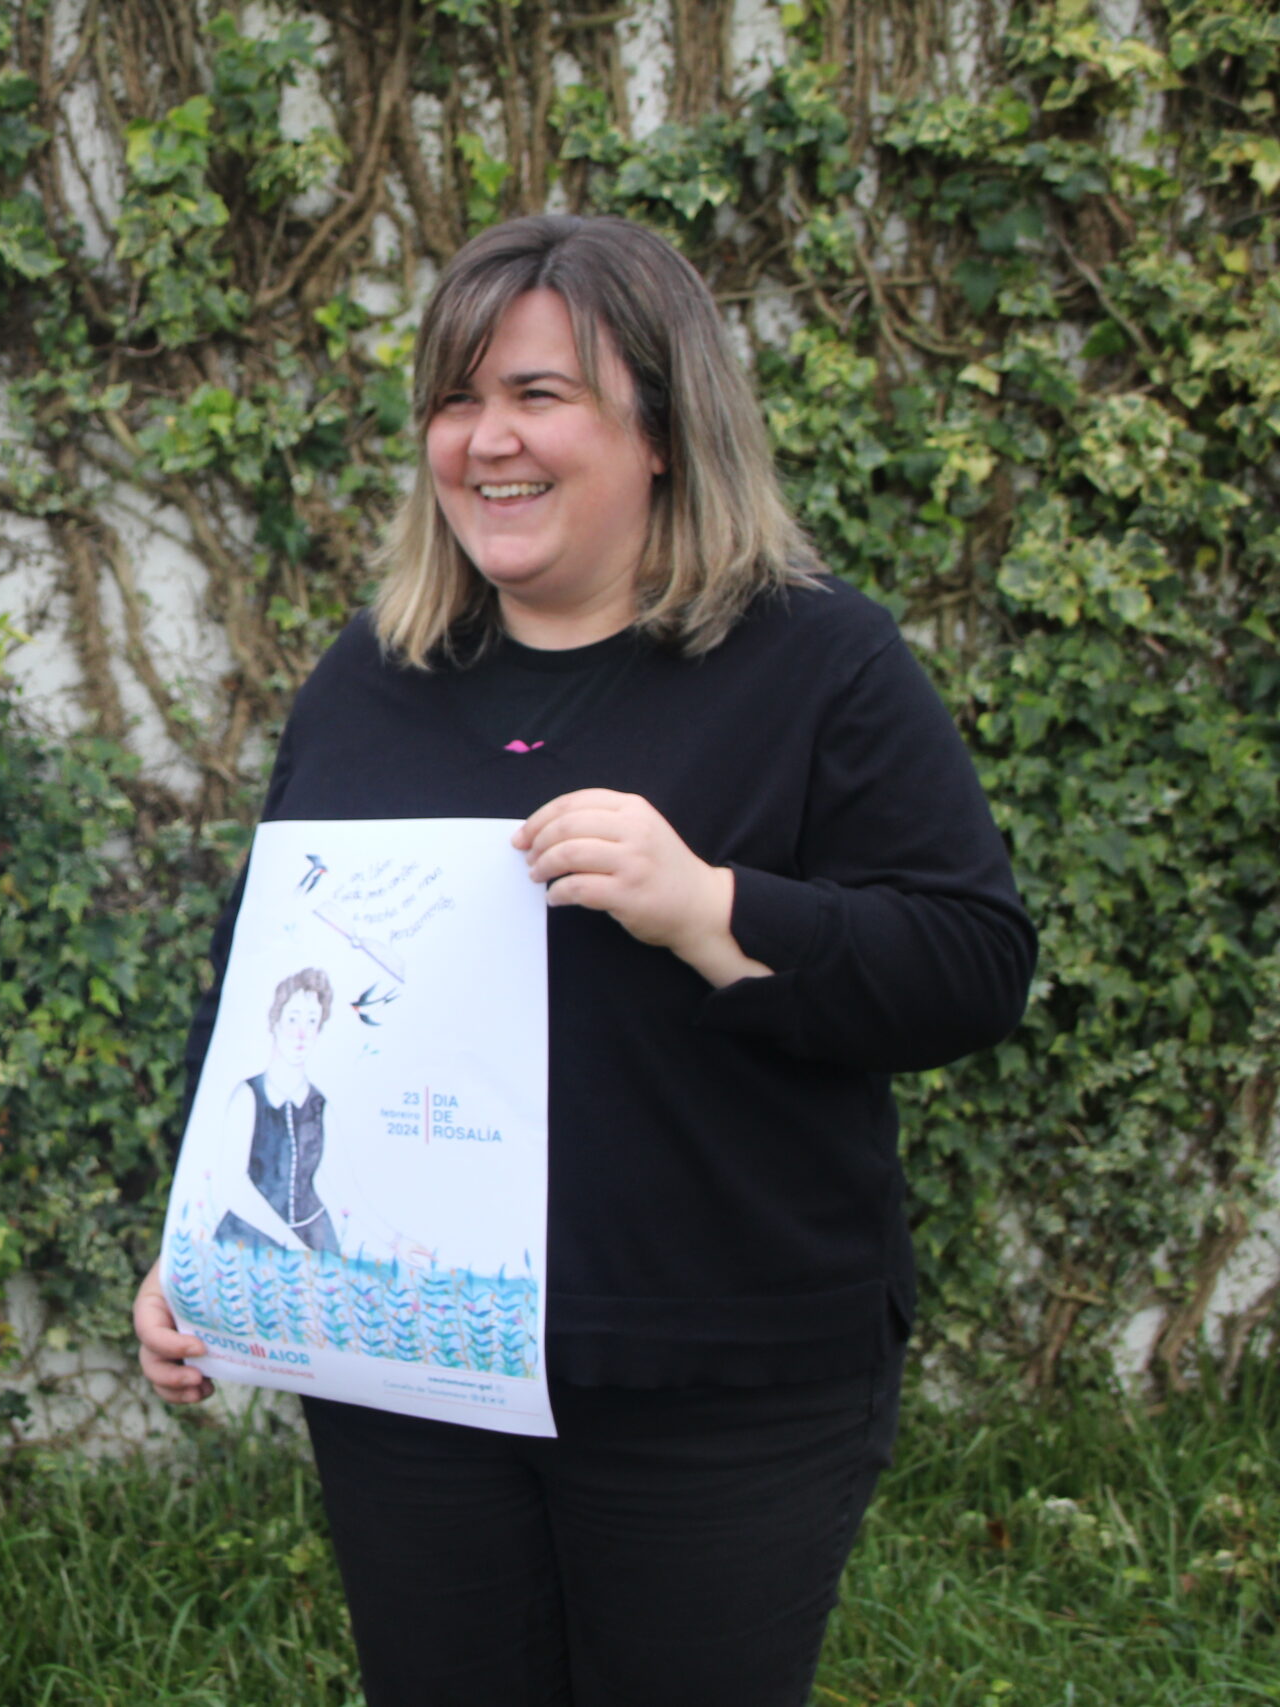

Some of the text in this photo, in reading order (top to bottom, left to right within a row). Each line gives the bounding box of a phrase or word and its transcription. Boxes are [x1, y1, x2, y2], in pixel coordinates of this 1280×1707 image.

[402, 1091, 420, 1105] 23
[432, 1093, 459, 1108] DIA
[432, 1109, 454, 1123] DE
[387, 1122, 420, 1136] 2024
